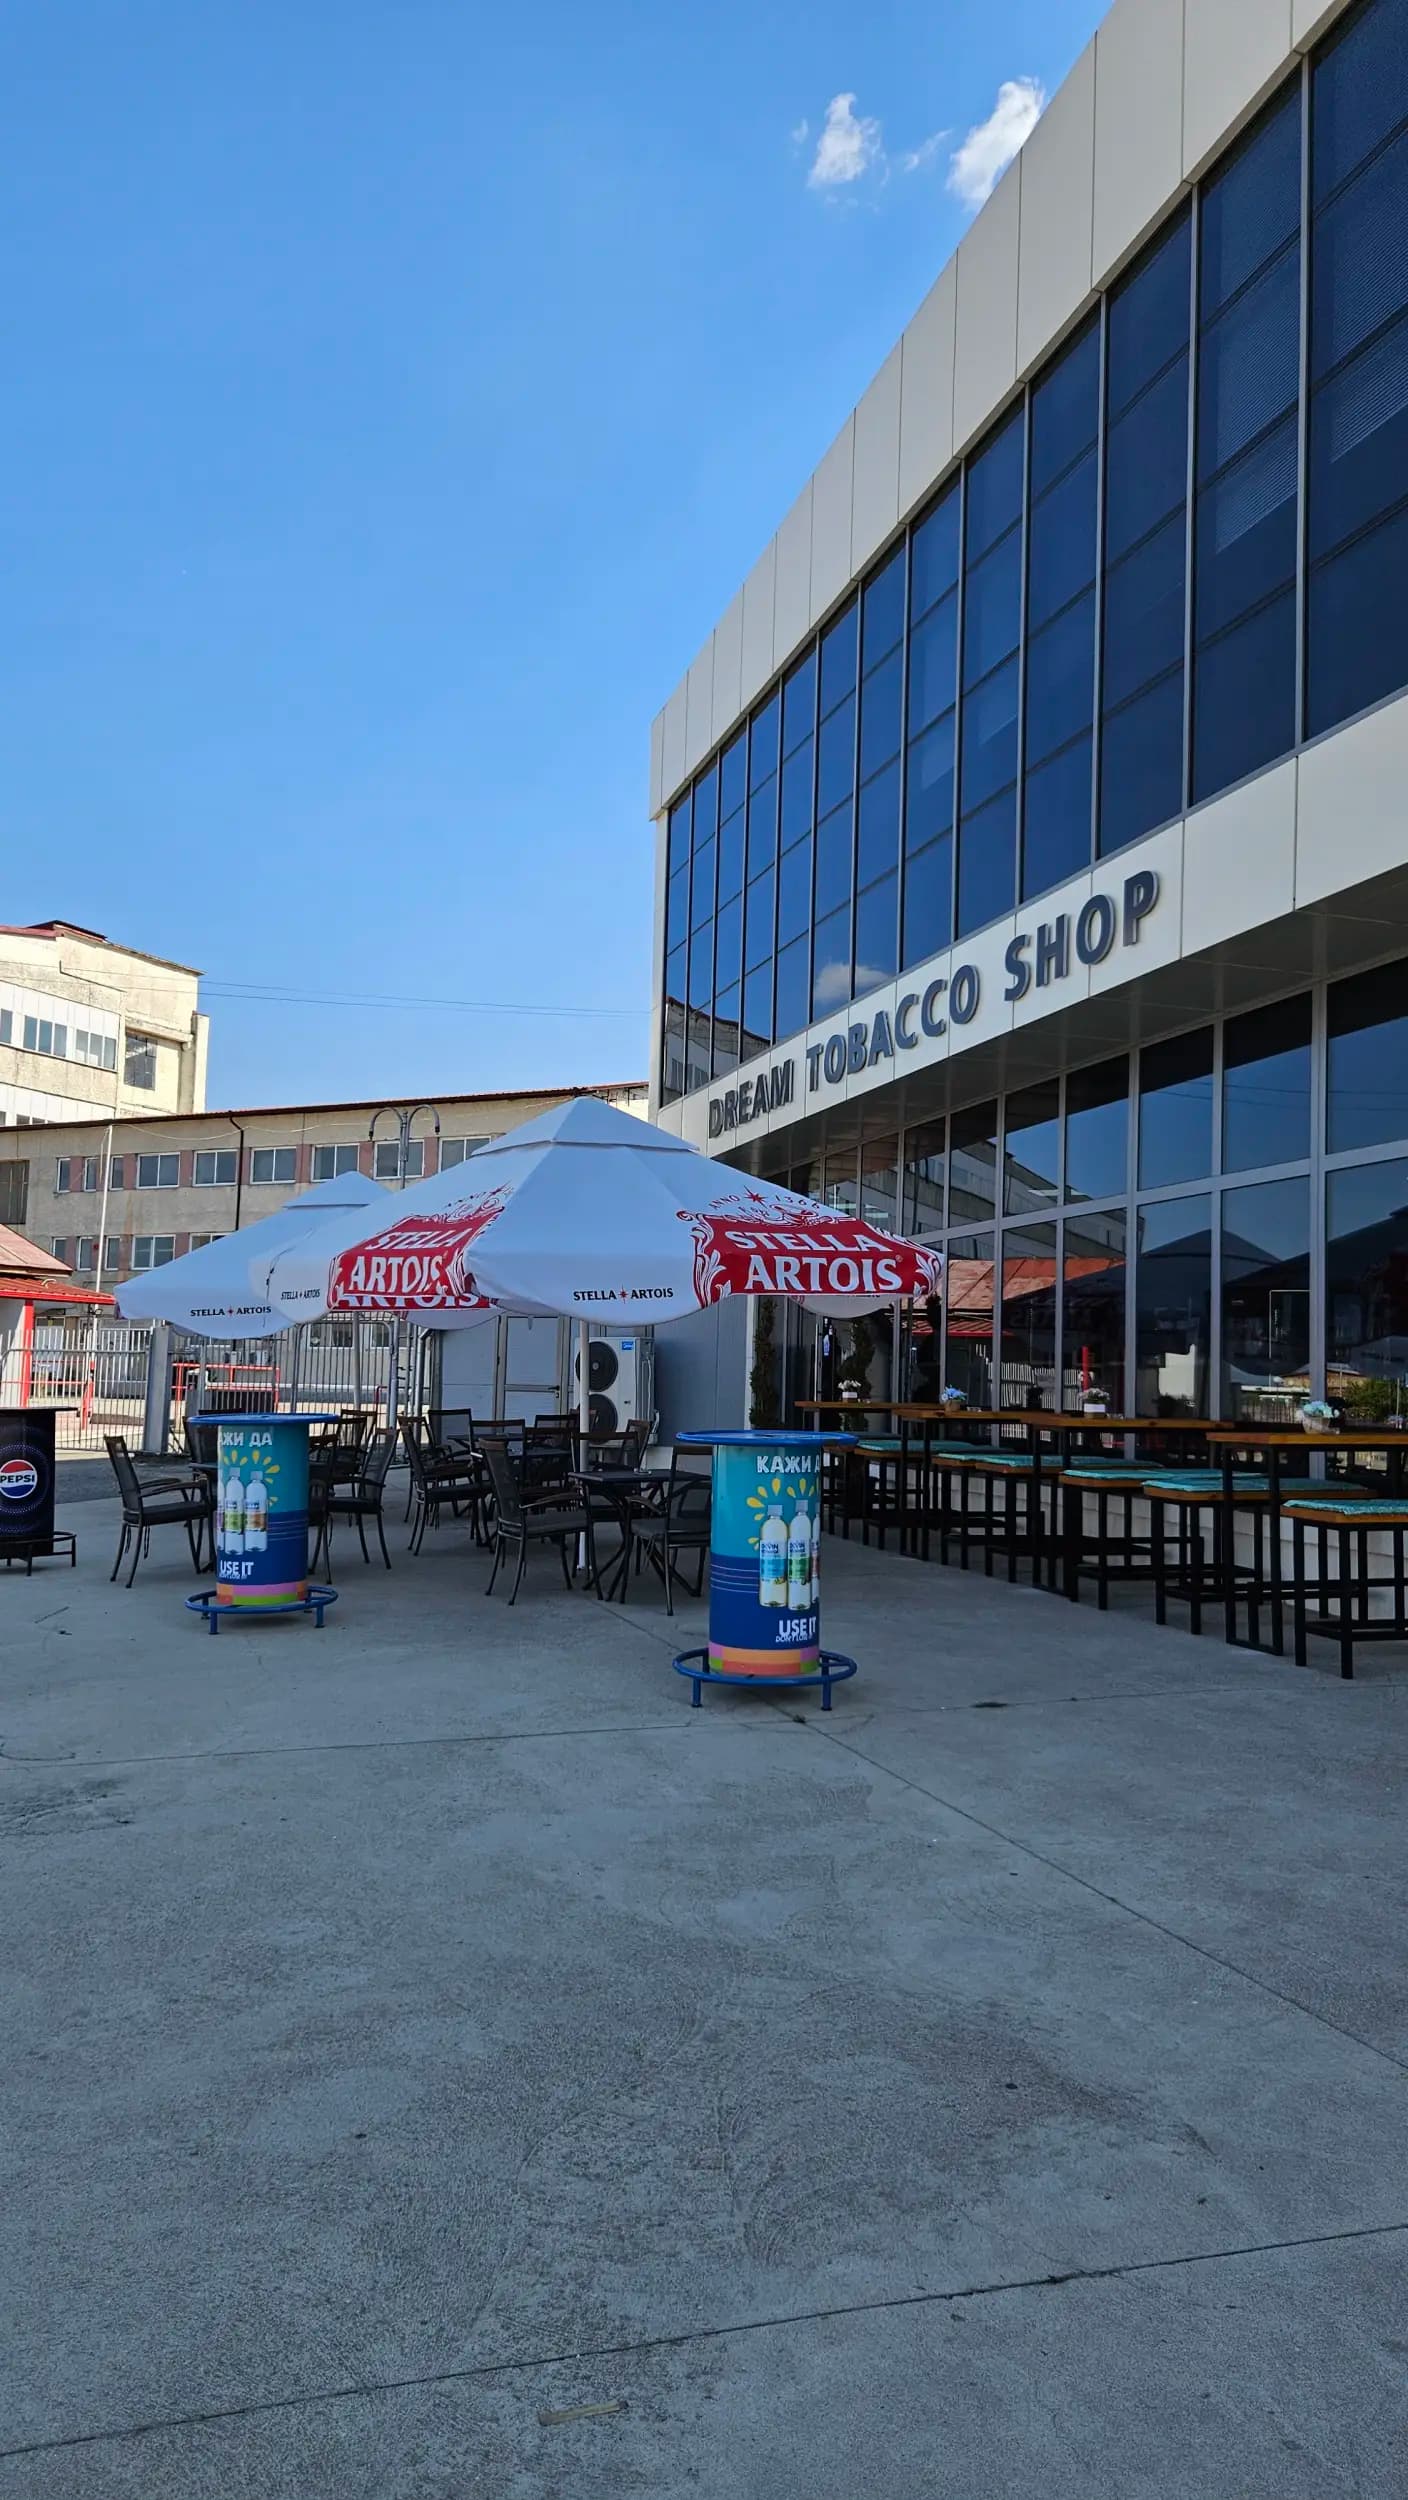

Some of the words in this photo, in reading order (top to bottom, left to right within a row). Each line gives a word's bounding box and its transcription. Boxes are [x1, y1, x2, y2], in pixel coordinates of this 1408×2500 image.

[708, 1058, 795, 1139] DREAM
[806, 964, 980, 1092] TOBACCO
[1003, 870, 1160, 1001] SHOP
[708, 1194, 741, 1210] ANNO
[364, 1228, 473, 1250] STELLA
[724, 1231, 893, 1252] STELLA
[348, 1255, 443, 1294] ARTOIS
[744, 1255, 903, 1292] ARTOIS
[281, 1290, 298, 1301] STELLA
[573, 1289, 617, 1301] STELLA
[630, 1287, 674, 1299] ARTOIS
[190, 1308, 226, 1317] STELLA
[236, 1306, 272, 1315] ARTOIS
[249, 1432, 273, 1447] ДА
[756, 1455, 812, 1473] КАЖИ
[0, 1474, 35, 1484] PEPSI
[220, 1560, 239, 1574] USE
[241, 1561, 254, 1576] IT
[778, 1618, 807, 1635] USE
[809, 1615, 817, 1633] IT
